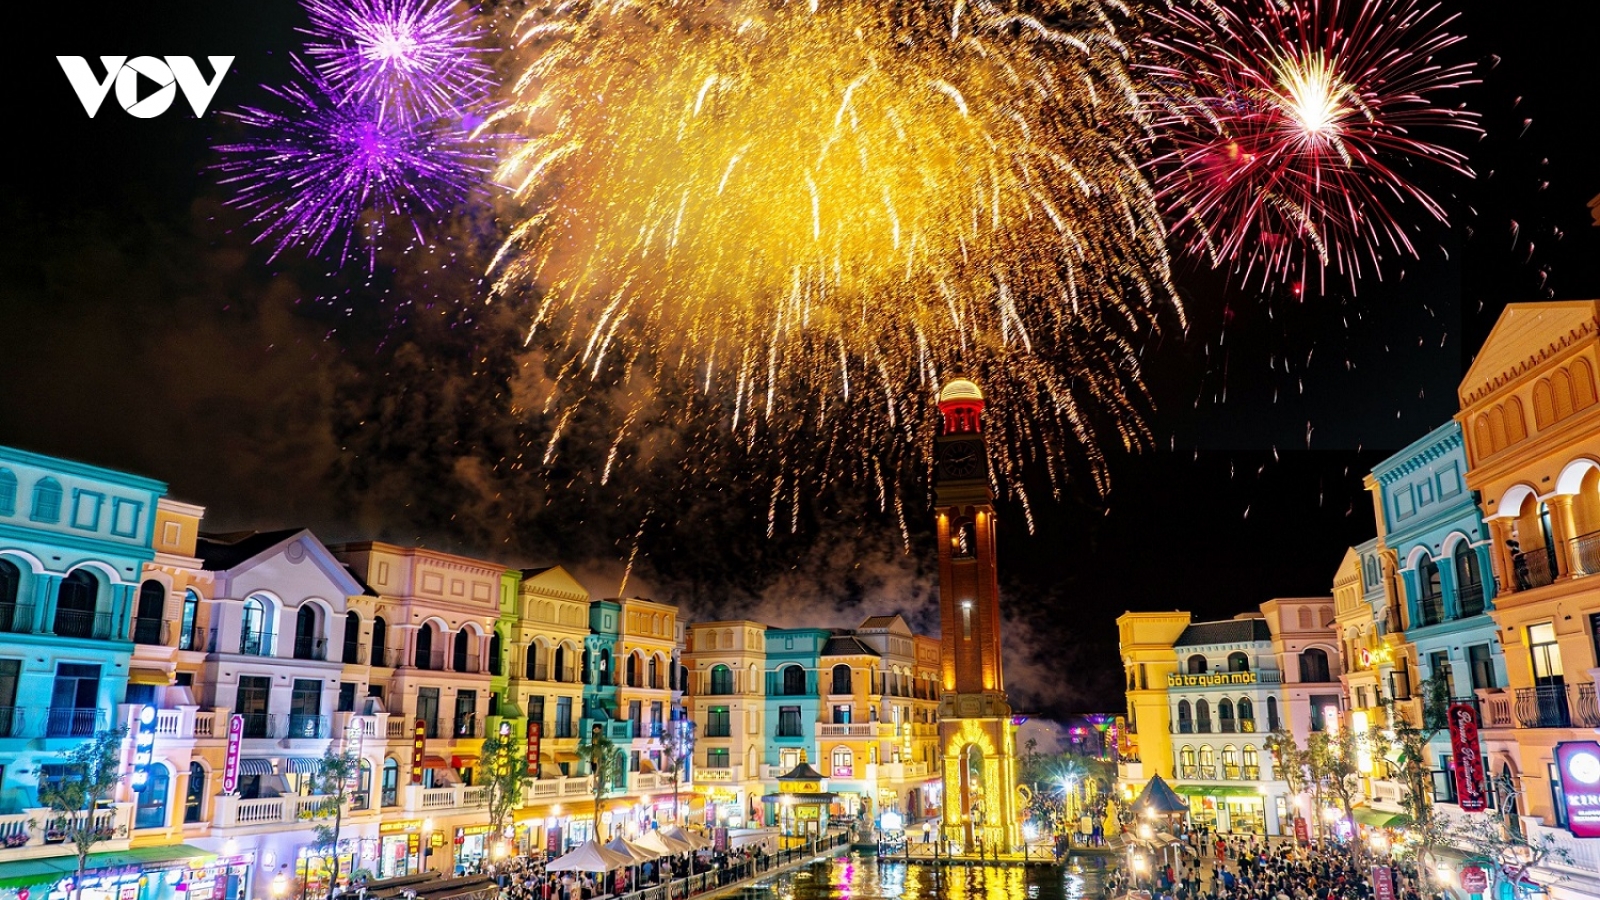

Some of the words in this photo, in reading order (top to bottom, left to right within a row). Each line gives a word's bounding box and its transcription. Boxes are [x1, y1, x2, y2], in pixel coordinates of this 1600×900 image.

[1198, 671, 1229, 688] quán
[1231, 670, 1257, 685] mộc
[1567, 794, 1600, 806] KIN
